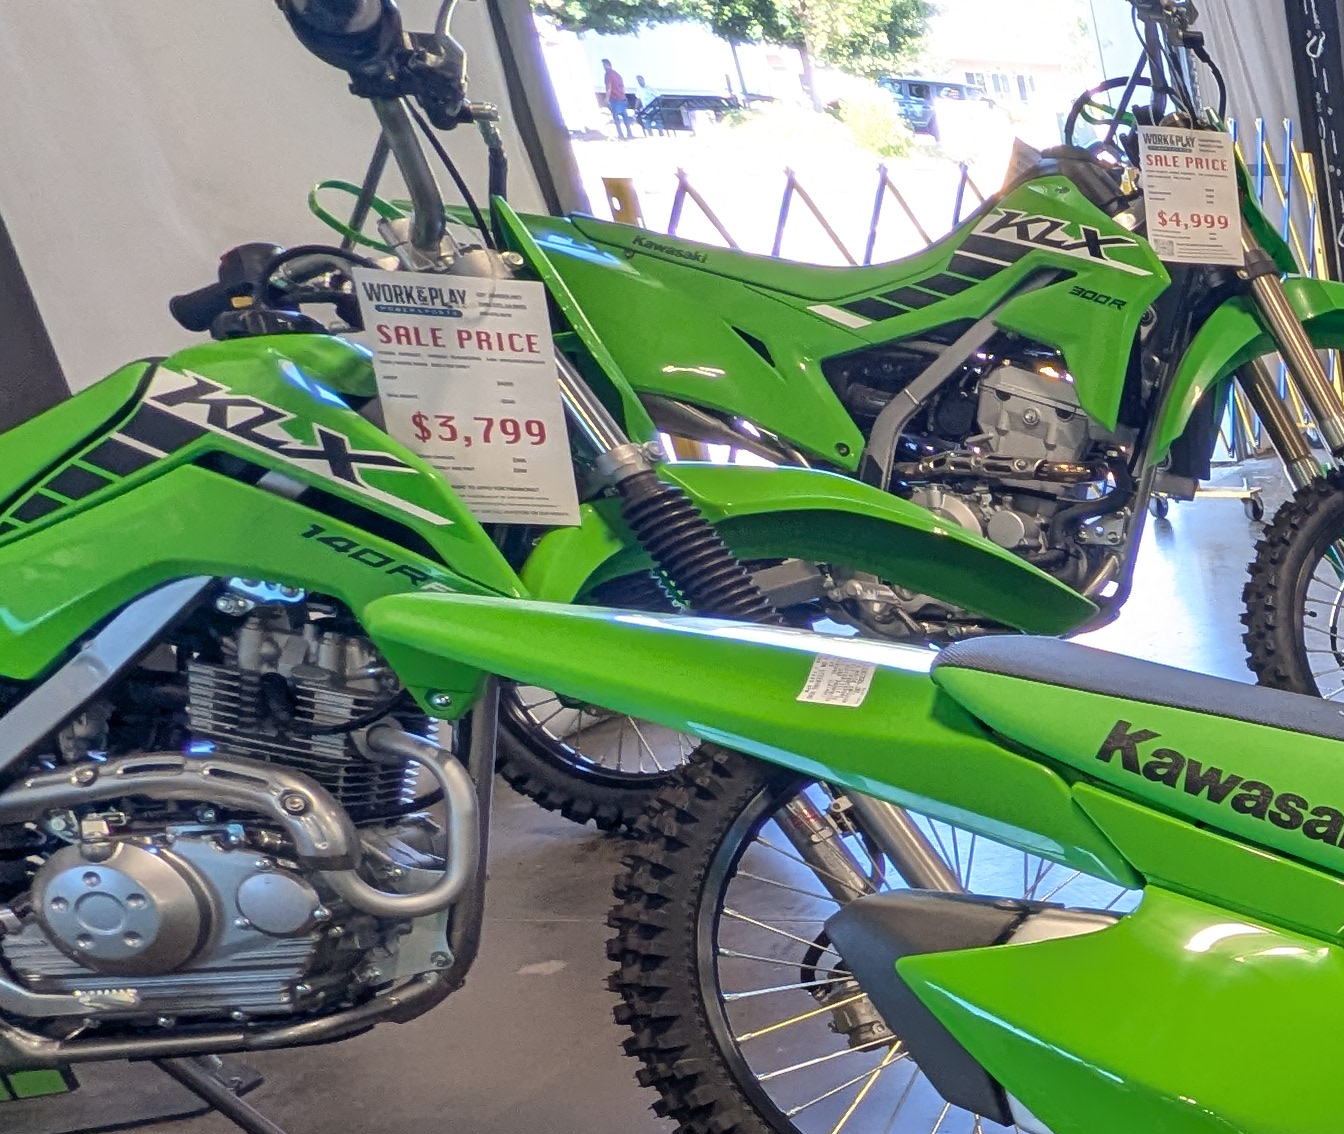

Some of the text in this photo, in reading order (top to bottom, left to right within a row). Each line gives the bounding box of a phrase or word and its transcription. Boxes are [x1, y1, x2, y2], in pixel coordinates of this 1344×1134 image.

[1146, 154, 1228, 171] SALE PRICE
[1157, 210, 1229, 229] $4,999
[632, 235, 708, 263] Kawasaki
[982, 210, 1138, 261] KLX
[362, 282, 467, 307] WORK&PLAY
[1068, 285, 1127, 310] 300R
[376, 324, 541, 353] SALE PRICE
[150, 373, 416, 488] KLX
[411, 411, 546, 448] $3,799
